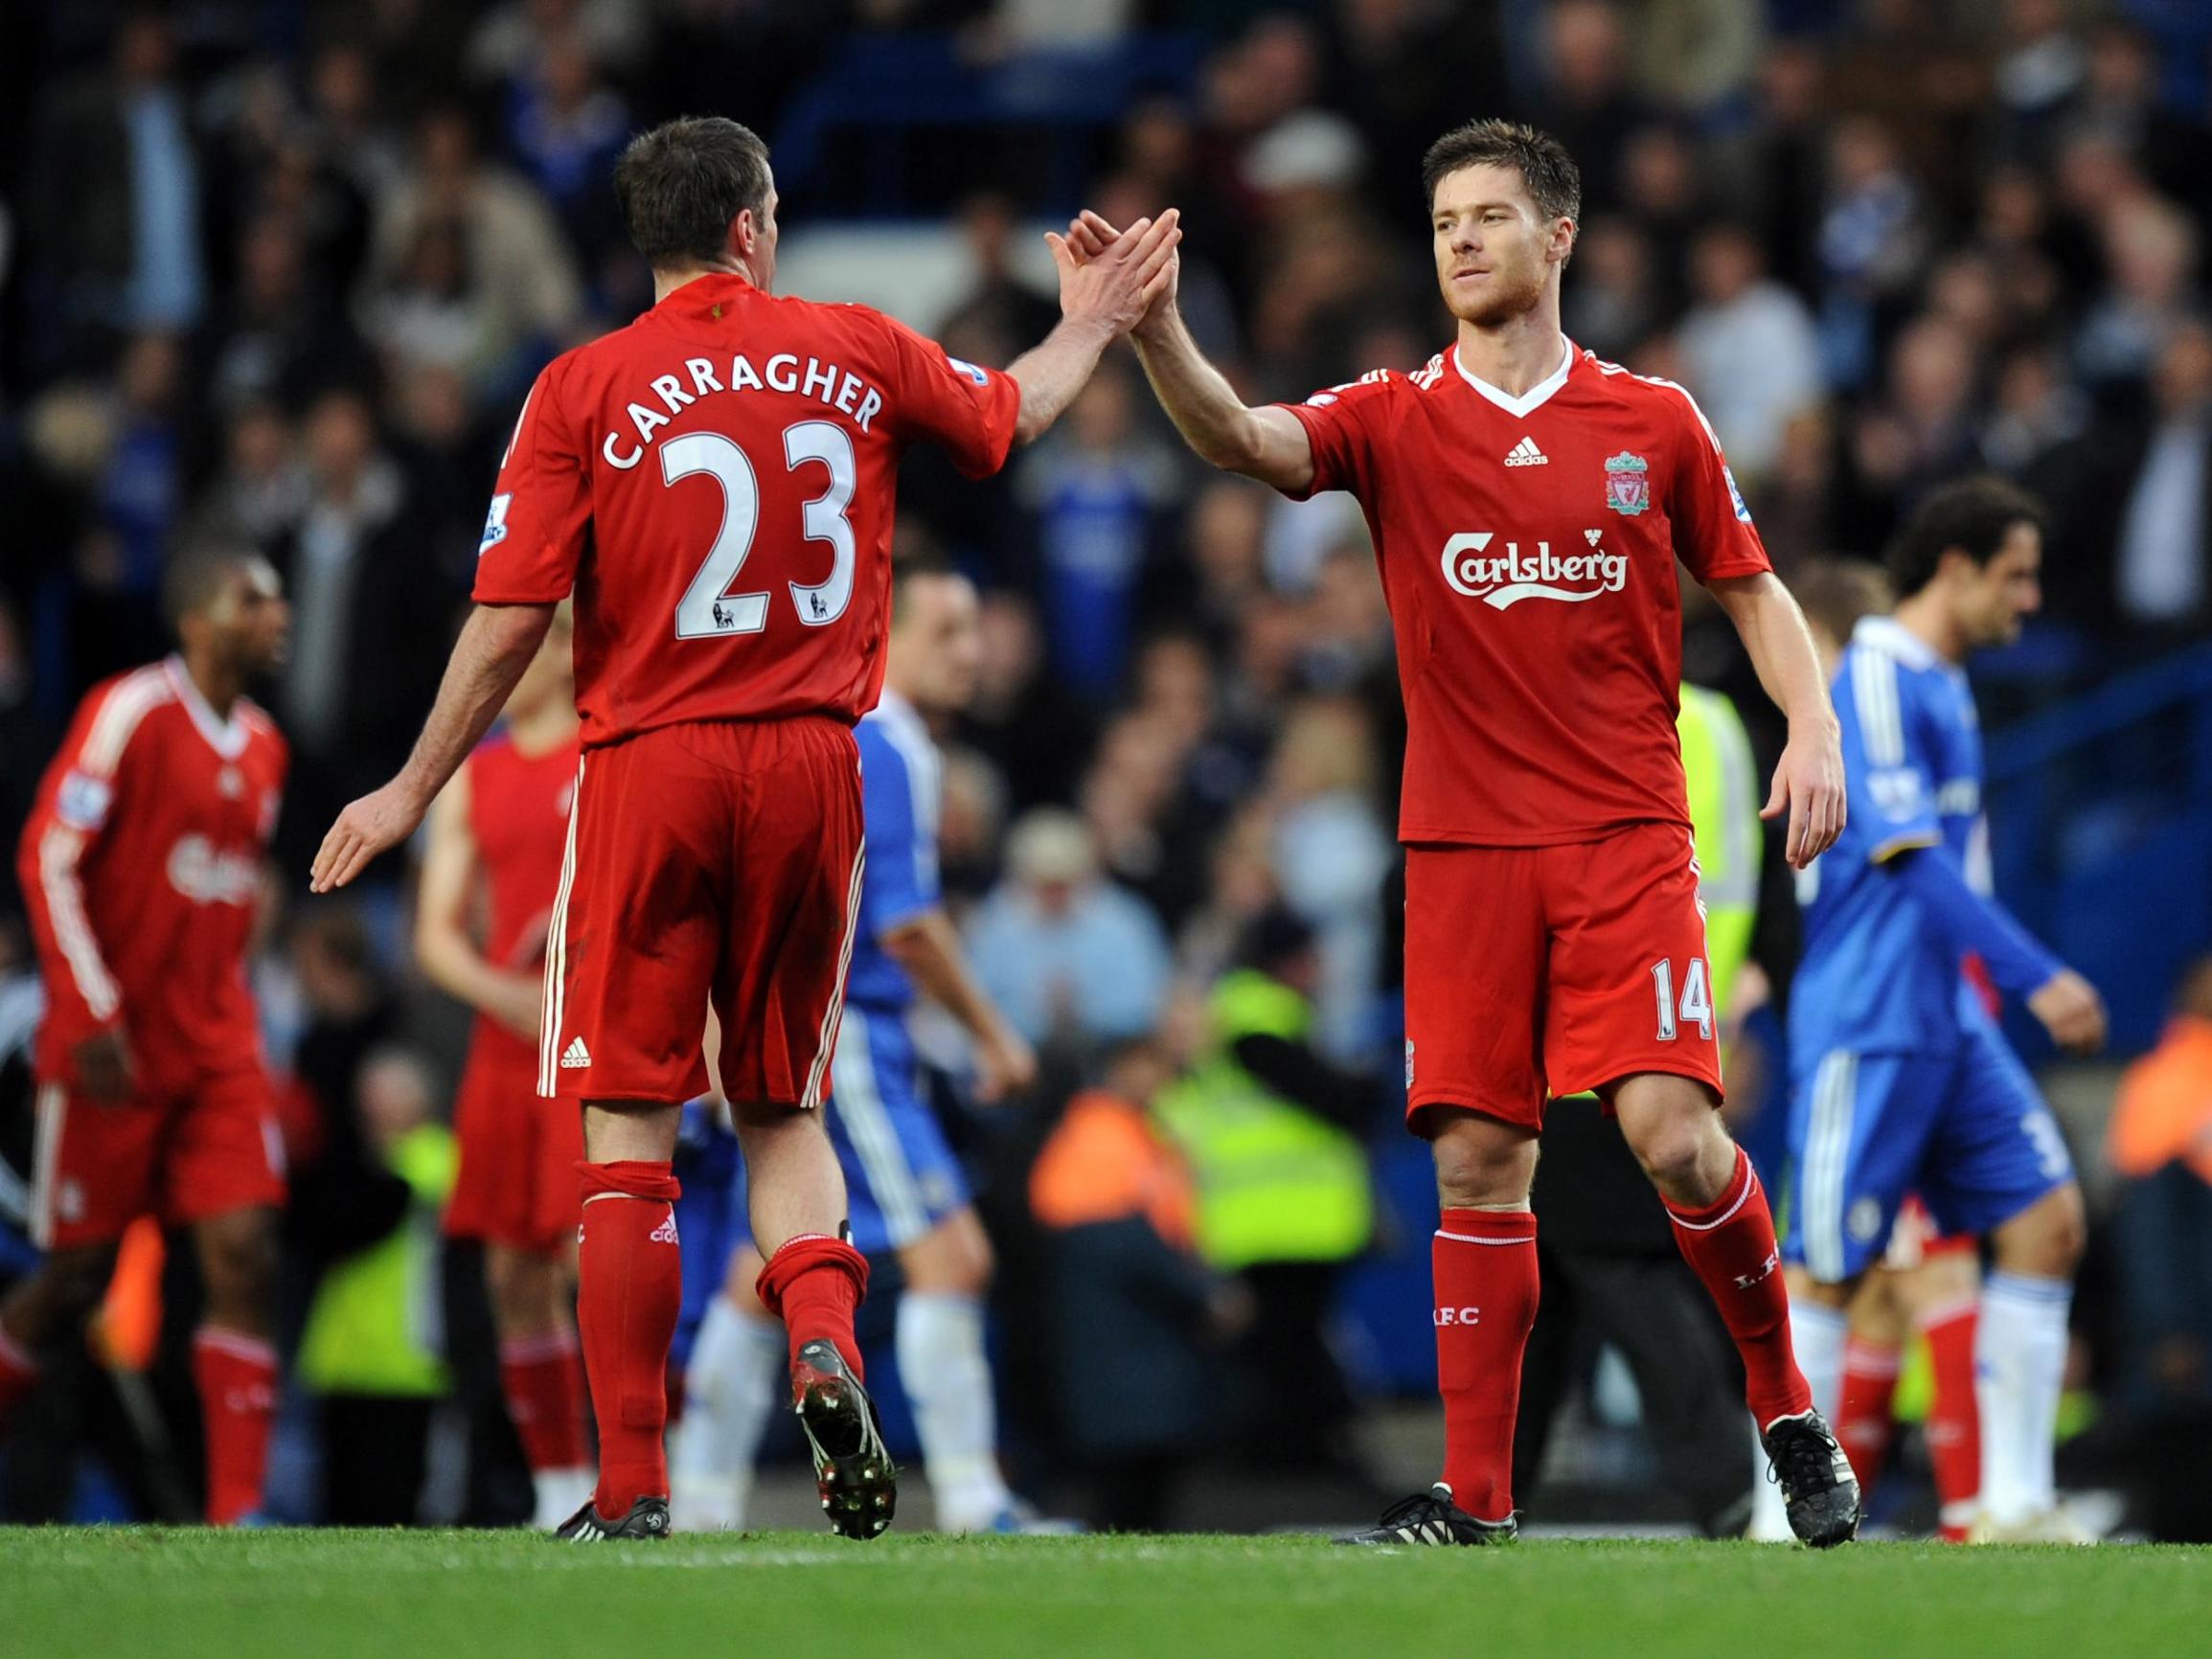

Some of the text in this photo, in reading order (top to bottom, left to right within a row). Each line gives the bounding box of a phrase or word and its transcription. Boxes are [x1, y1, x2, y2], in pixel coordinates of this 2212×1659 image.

[603, 353, 883, 470] CARRAGHER
[1504, 454, 1549, 467] adidas
[660, 420, 856, 640] 23
[1441, 533, 1629, 610] Carlsberg
[1651, 958, 1712, 1041] 14
